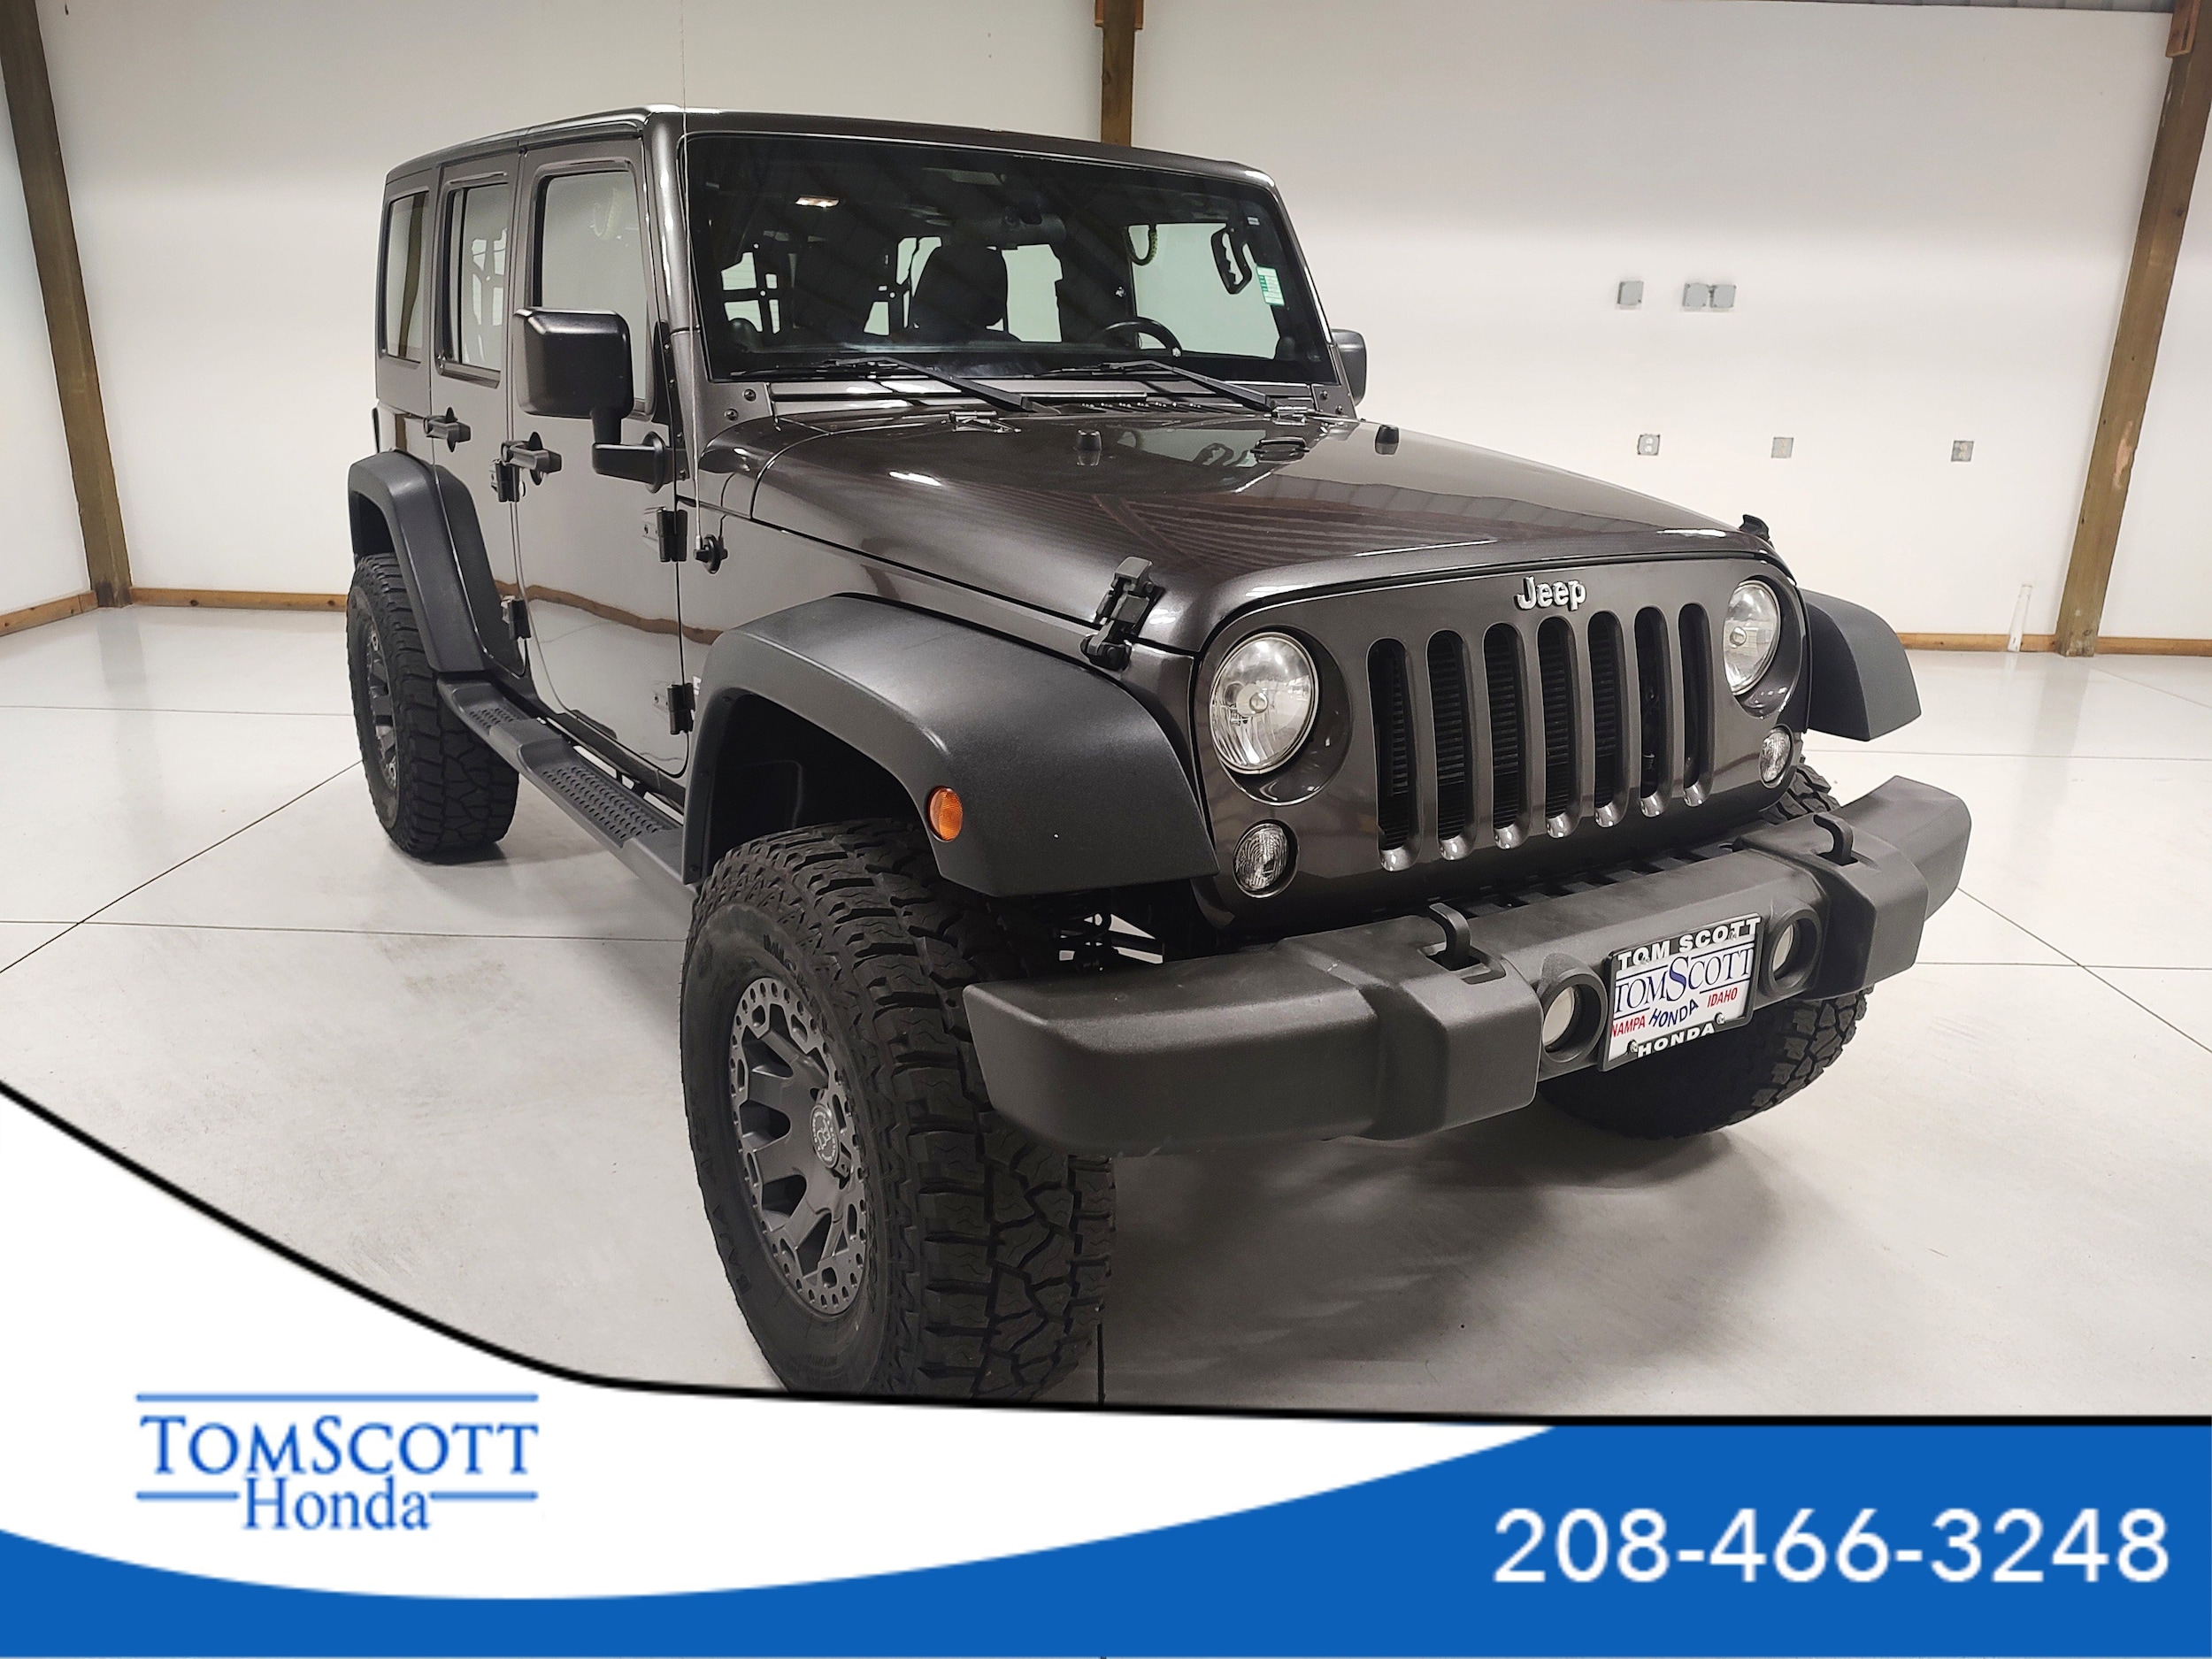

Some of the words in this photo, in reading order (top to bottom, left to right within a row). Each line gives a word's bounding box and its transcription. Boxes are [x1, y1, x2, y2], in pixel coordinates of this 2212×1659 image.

[1514, 576, 1586, 611] Jeep
[1617, 941, 1670, 971] TOM
[1678, 917, 1761, 953] SCOTT
[1611, 1015, 1646, 1038] NAMPA
[1648, 999, 1699, 1028] HONDA
[1707, 987, 1738, 1008] IDAHO
[1638, 1022, 1715, 1058] HONDA
